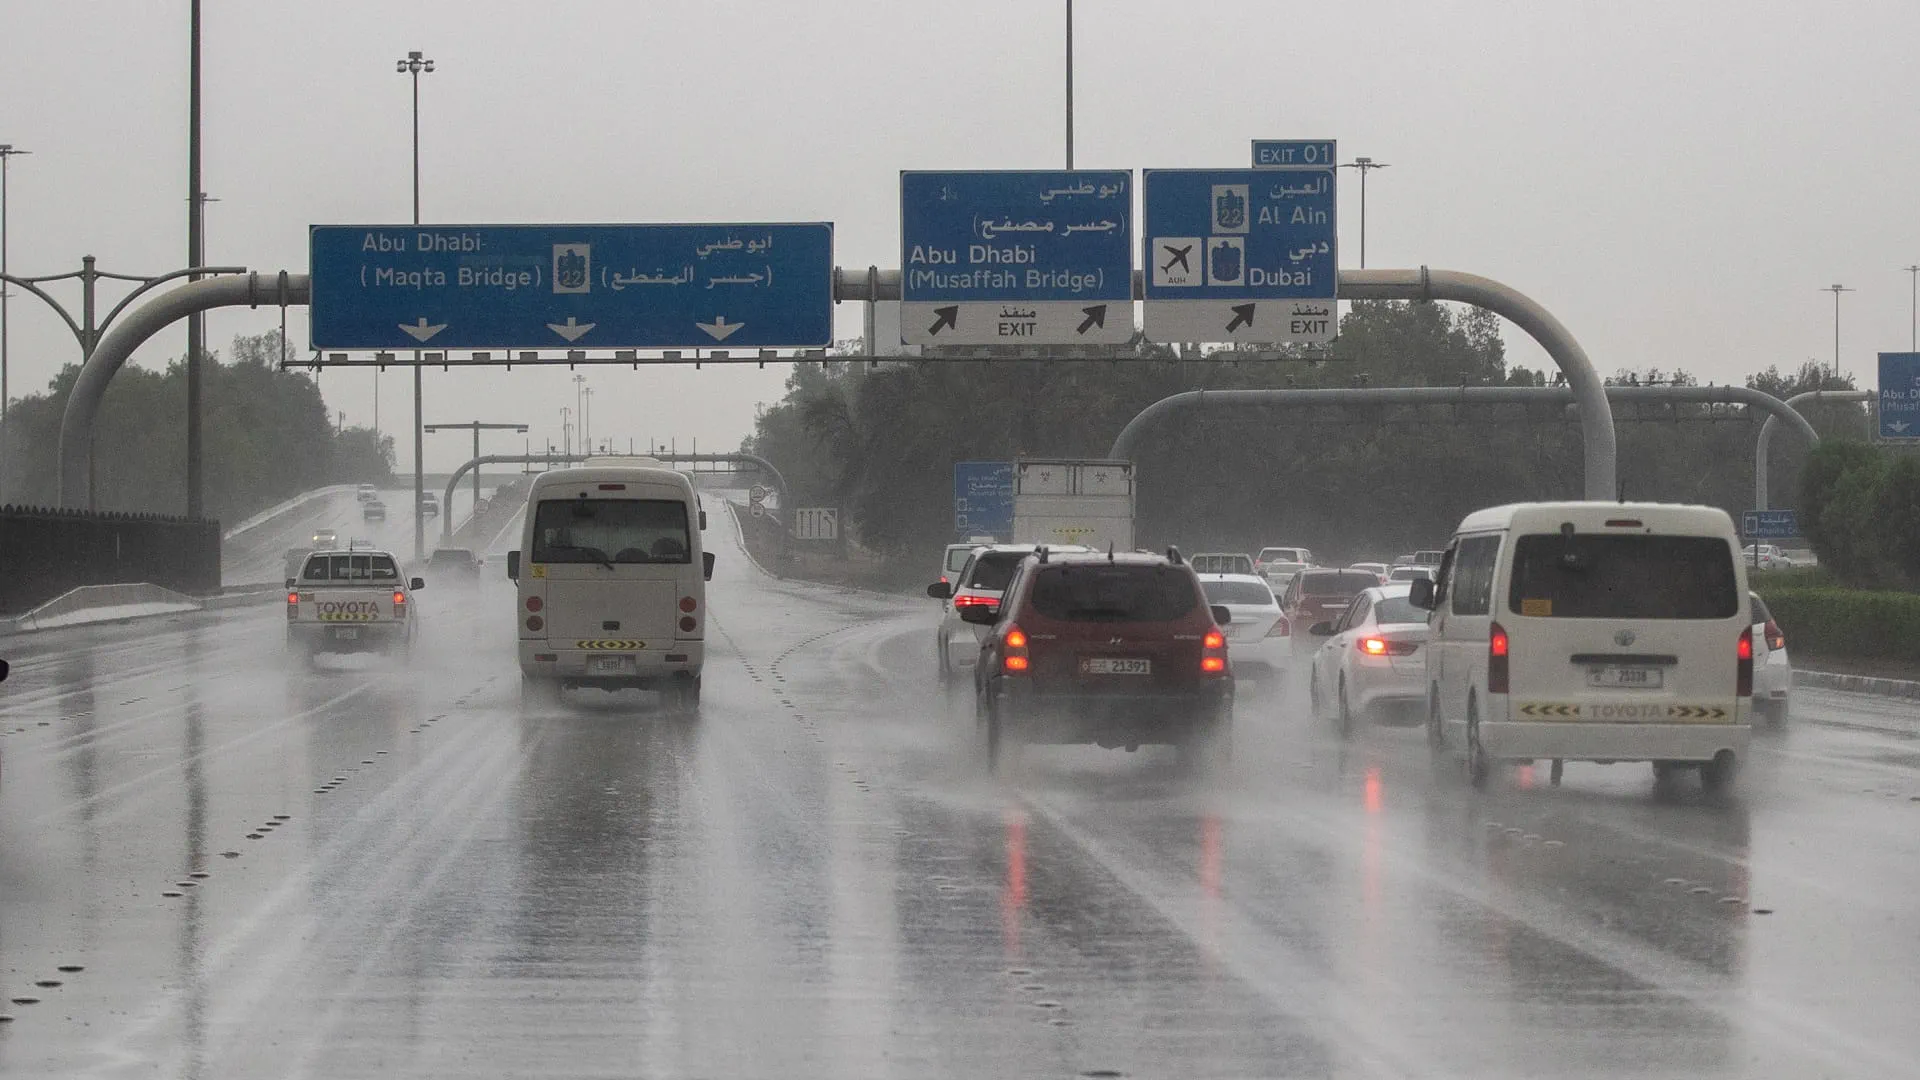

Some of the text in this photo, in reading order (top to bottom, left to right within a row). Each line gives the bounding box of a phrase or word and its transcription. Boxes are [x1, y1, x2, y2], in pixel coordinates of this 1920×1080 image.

[1260, 144, 1330, 163] EXIT 01
[1269, 176, 1328, 199] العين
[1258, 206, 1327, 225] Al Ain
[362, 232, 482, 251] Abu Dhabi
[910, 244, 1036, 264] Abu Dhabi
[1288, 240, 1330, 264] دبي
[458, 265, 542, 290] Bridge)
[909, 268, 1104, 292] (Musaffah Bridge)
[1250, 267, 1312, 286] Dubai
[999, 304, 1037, 318] منفذ
[1291, 303, 1329, 316] منفذ
[998, 322, 1037, 336] EXIT
[1290, 320, 1329, 334] EXIT
[1882, 389, 1905, 400] Abu
[314, 601, 380, 614] TOYOTA
[1111, 660, 1148, 673] 21391
[1590, 703, 1663, 718] TOYOTA
